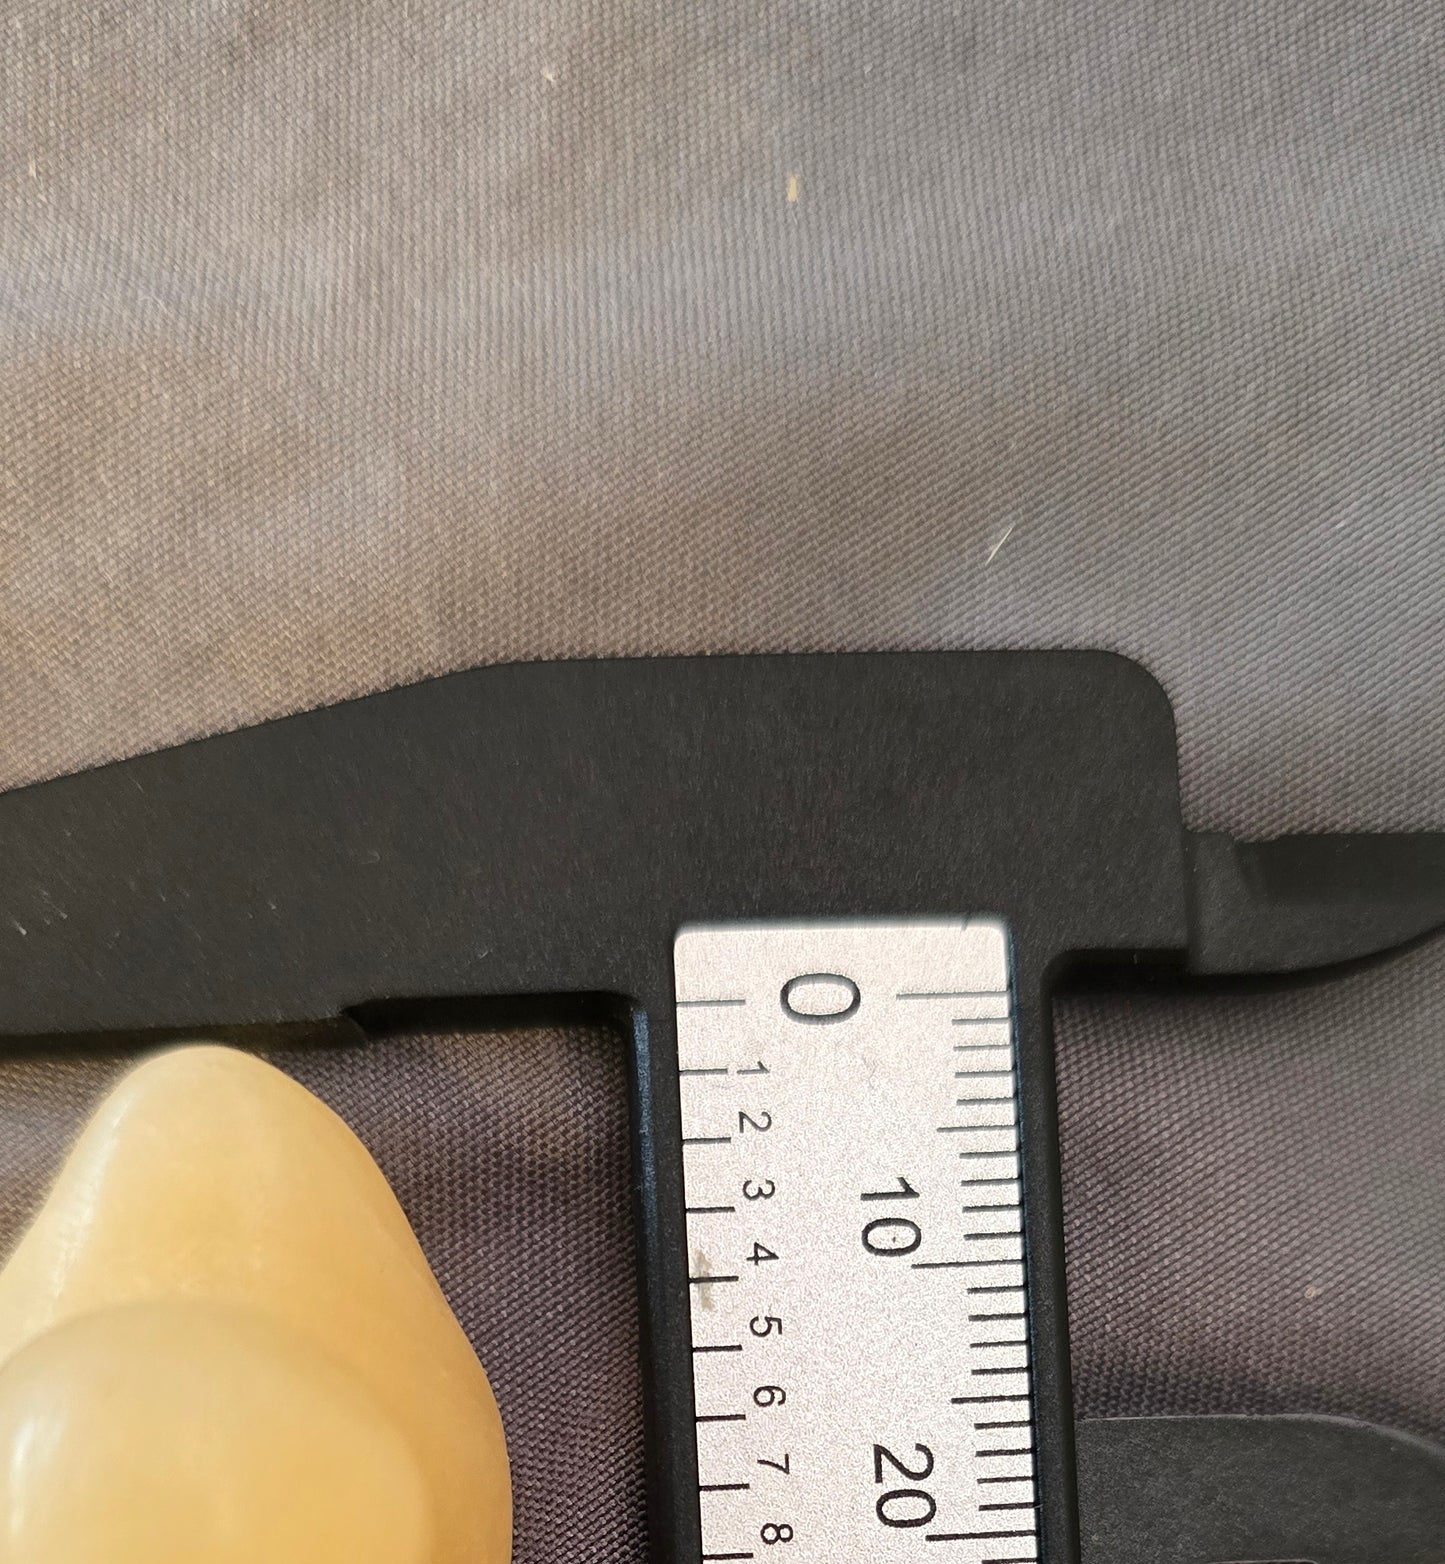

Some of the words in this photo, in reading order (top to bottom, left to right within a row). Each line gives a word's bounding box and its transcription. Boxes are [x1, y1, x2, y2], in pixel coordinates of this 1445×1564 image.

[780, 973, 861, 1024] 0
[737, 1060, 770, 1076] 1
[739, 1110, 772, 1134] 2
[743, 1179, 775, 1201] 3
[860, 1177, 921, 1256] 10
[746, 1242, 780, 1266] 4
[749, 1315, 783, 1337] 5
[753, 1385, 787, 1407] 6
[757, 1453, 790, 1474] 7
[873, 1443, 936, 1528] 20
[760, 1522, 794, 1545] 8
